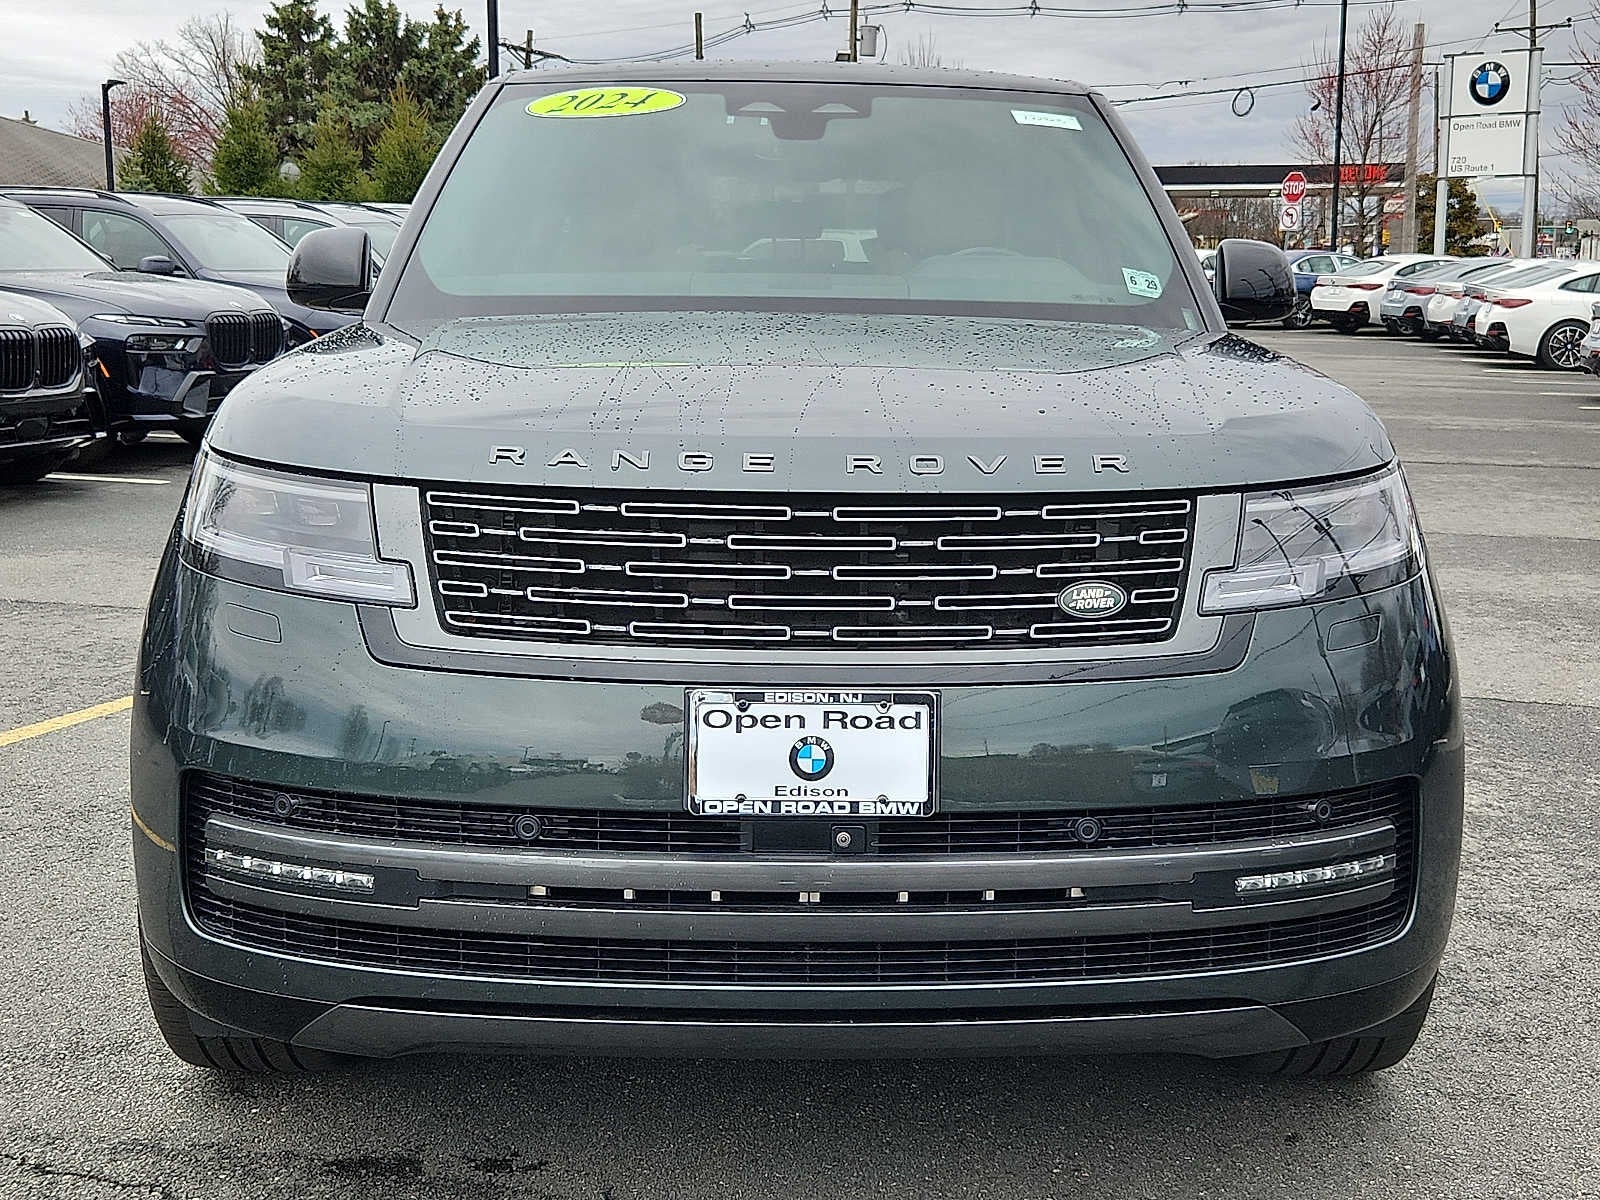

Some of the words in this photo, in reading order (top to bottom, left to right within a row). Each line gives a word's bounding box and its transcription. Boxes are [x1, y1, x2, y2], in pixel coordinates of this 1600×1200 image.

[1473, 63, 1507, 78] BMW
[546, 92, 658, 113] 2024
[1453, 123, 1475, 132] Open
[1476, 121, 1497, 129] Road
[1498, 119, 1521, 128] BMW
[1451, 156, 1467, 164] 720
[1464, 164, 1488, 172] Route
[1283, 181, 1305, 195] STOP
[1129, 275, 1137, 286] 6
[1144, 279, 1158, 290] 29
[488, 445, 775, 473] RANGE
[845, 454, 1130, 475] ROVER
[1072, 588, 1105, 600] LAND
[1075, 597, 1115, 609] ROVER
[764, 692, 834, 704] EDISON,
[839, 692, 864, 703] NJ
[702, 709, 806, 733] Open
[822, 710, 922, 730] Road
[795, 736, 831, 751] BMW
[774, 785, 849, 797] Edison
[704, 801, 772, 814] OPEN
[780, 801, 852, 814] ROAD
[859, 801, 920, 815] BMW
